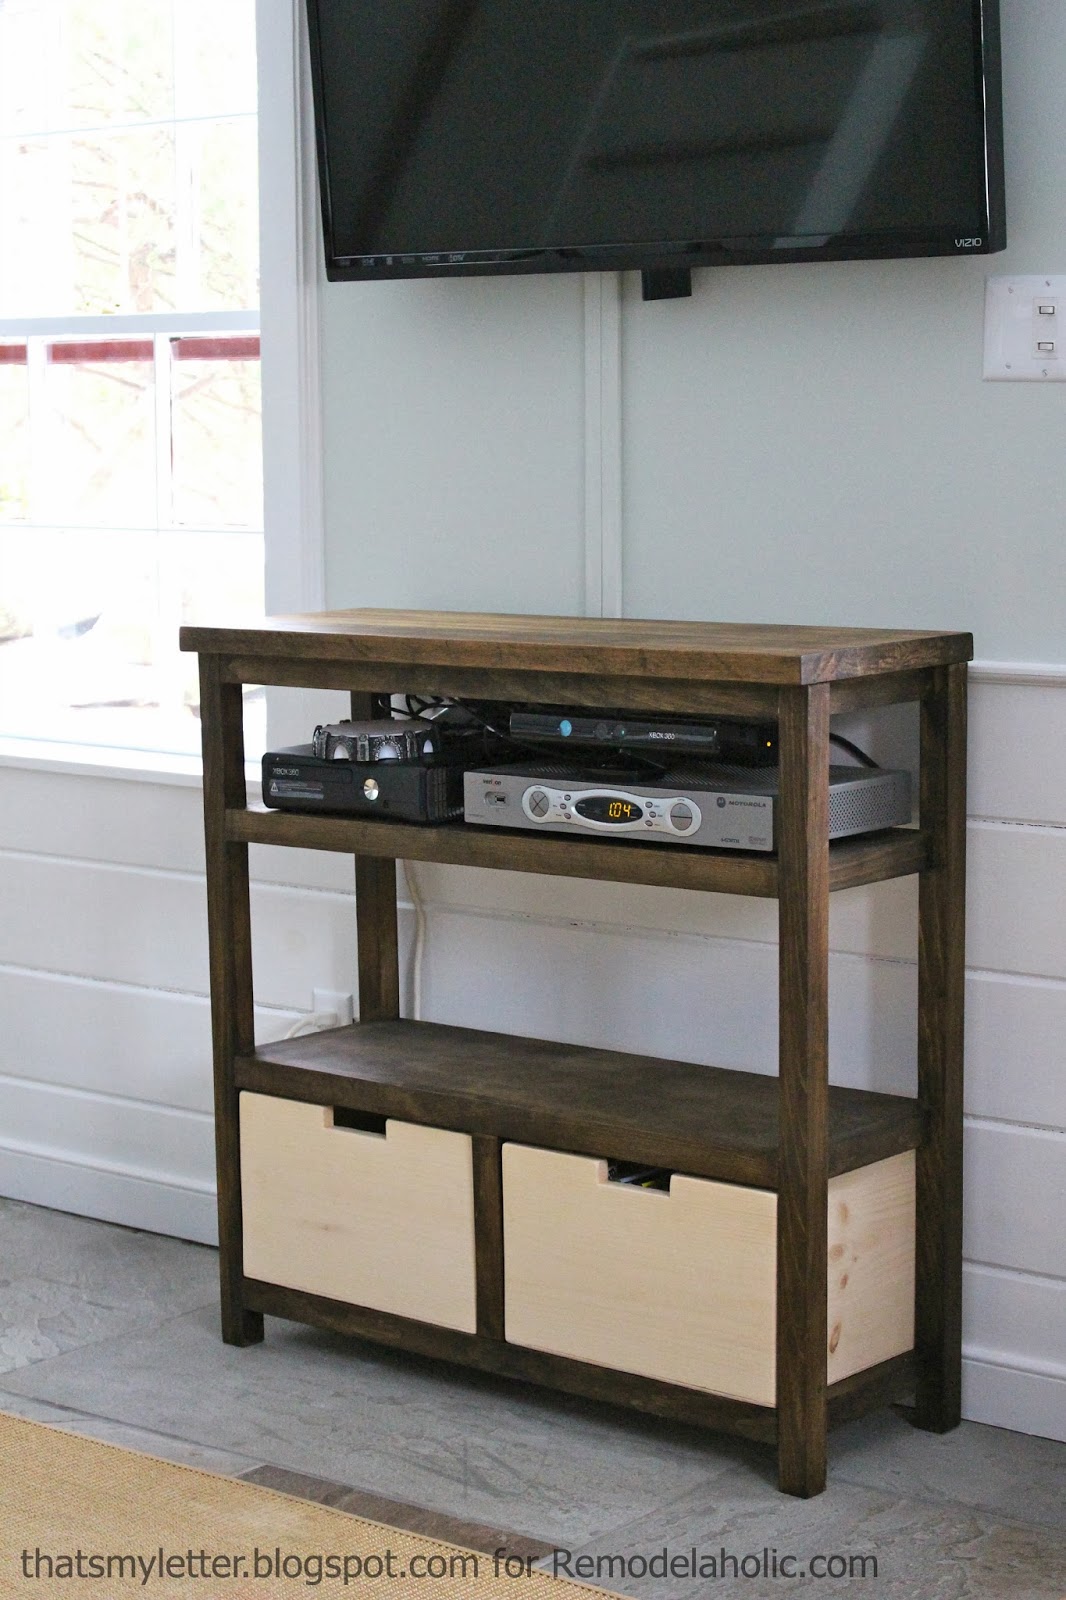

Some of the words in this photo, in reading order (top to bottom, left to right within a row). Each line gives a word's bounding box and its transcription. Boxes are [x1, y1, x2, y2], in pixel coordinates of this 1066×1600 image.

[954, 237, 982, 248] VIZIO
[649, 731, 664, 739] XBOX
[272, 767, 288, 776] XBOX
[728, 800, 767, 808] MOTOROLA
